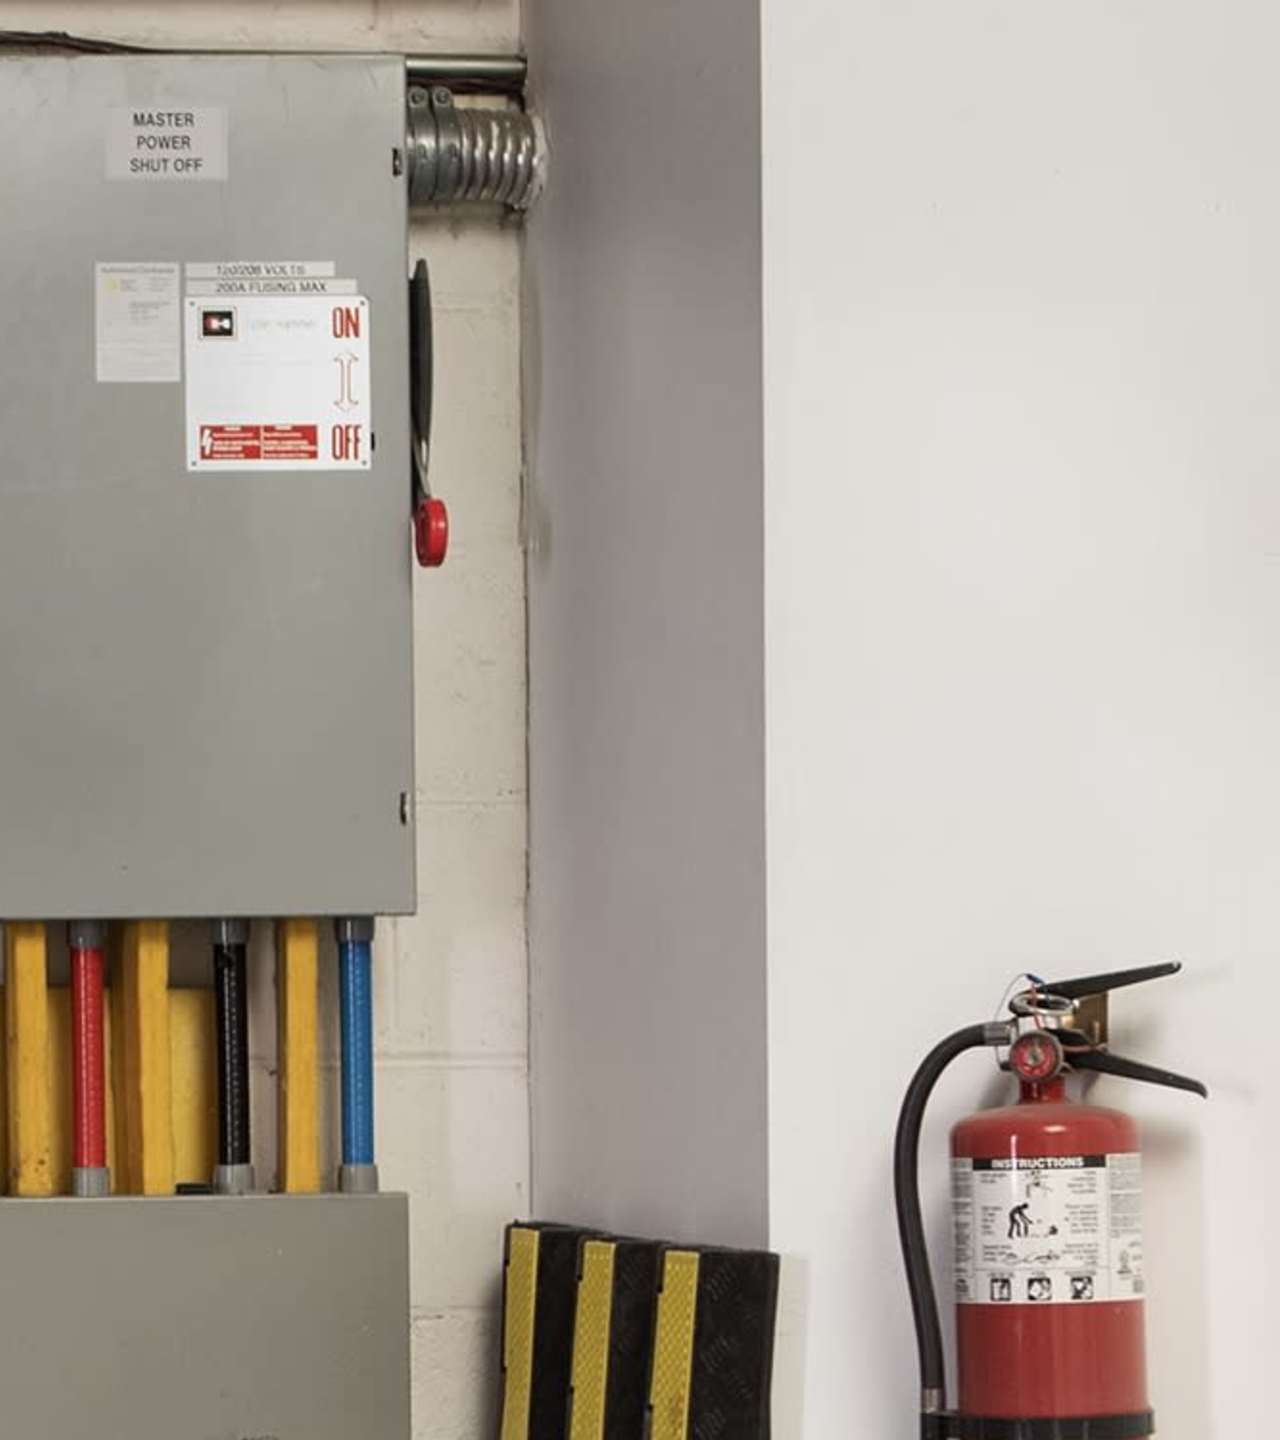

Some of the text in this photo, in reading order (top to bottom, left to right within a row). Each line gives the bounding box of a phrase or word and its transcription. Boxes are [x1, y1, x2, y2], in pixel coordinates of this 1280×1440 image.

[132, 113, 195, 128] MASTER
[136, 134, 192, 150] POWER
[130, 157, 204, 173] SHUT OFF
[264, 264, 306, 275] VOLTS
[248, 281, 298, 293] FUSING
[299, 281, 328, 293] MAX
[332, 306, 361, 339] ON
[331, 424, 361, 461] OFF
[991, 1157, 1084, 1169] INSTRUCTIONS
